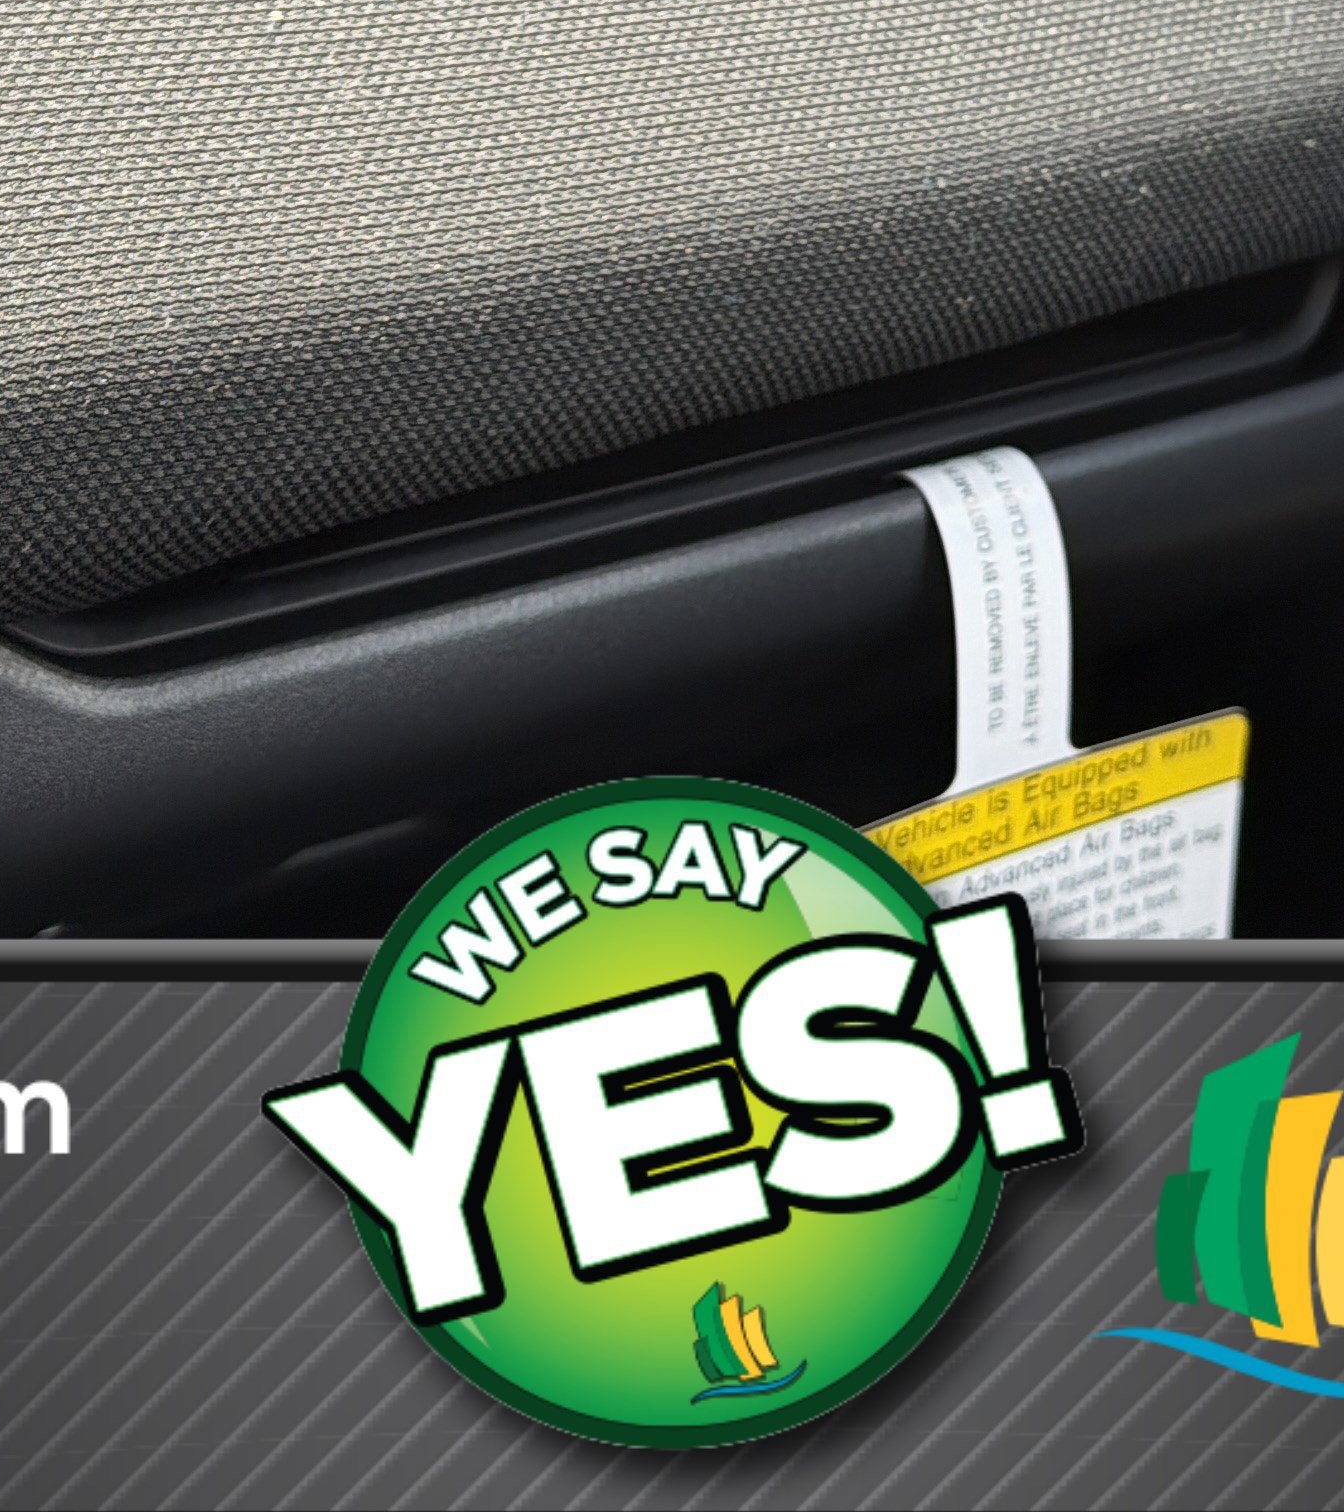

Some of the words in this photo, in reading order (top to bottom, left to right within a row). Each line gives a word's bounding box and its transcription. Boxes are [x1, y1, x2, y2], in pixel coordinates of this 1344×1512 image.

[874, 800, 975, 850] Vehicle
[987, 789, 1009, 815] is
[1022, 743, 1148, 803] Equipped
[1160, 729, 1213, 759] with
[1023, 804, 1061, 836] Air
[1073, 781, 1139, 819] Bags
[959, 841, 1071, 898] Advanced
[1078, 831, 1110, 859] Air
[1119, 809, 1175, 844] Bags
